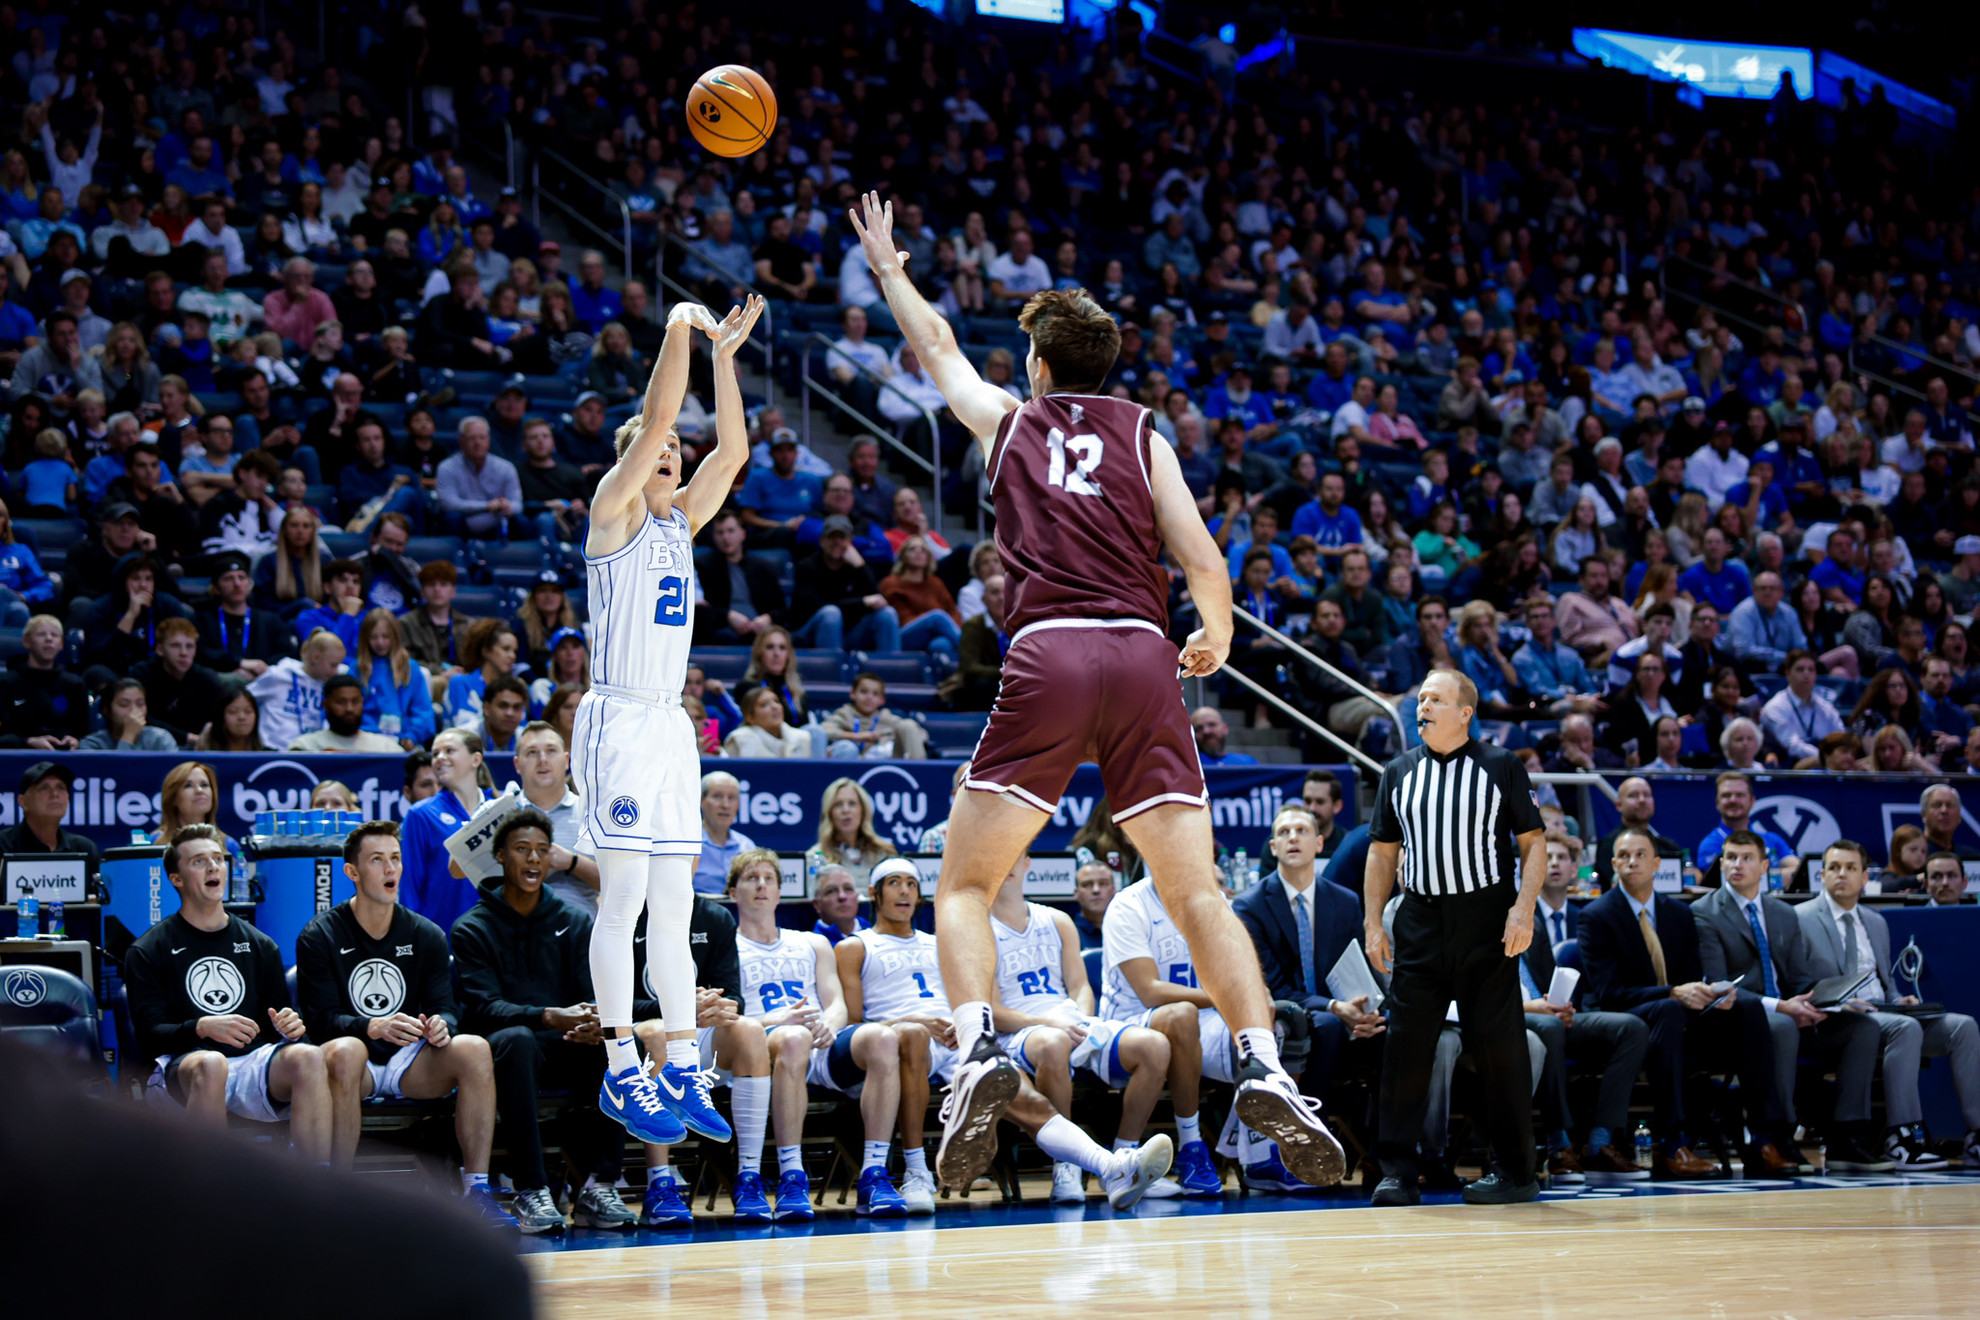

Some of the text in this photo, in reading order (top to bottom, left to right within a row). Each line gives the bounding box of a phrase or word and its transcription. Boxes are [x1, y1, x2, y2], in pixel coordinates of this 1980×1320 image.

[1046, 427, 1104, 497] 12
[1212, 786, 1304, 827] mili
[32, 874, 77, 888] vivint
[316, 864, 331, 913] POWE
[1040, 871, 1070, 882] vivint
[150, 866, 162, 925] ERADE
[743, 958, 811, 988] BYU
[1002, 944, 1060, 977] BYU
[1169, 963, 1198, 989] 5
[912, 972, 934, 998] 1
[1017, 966, 1059, 996] 21
[759, 981, 810, 1013] 25
